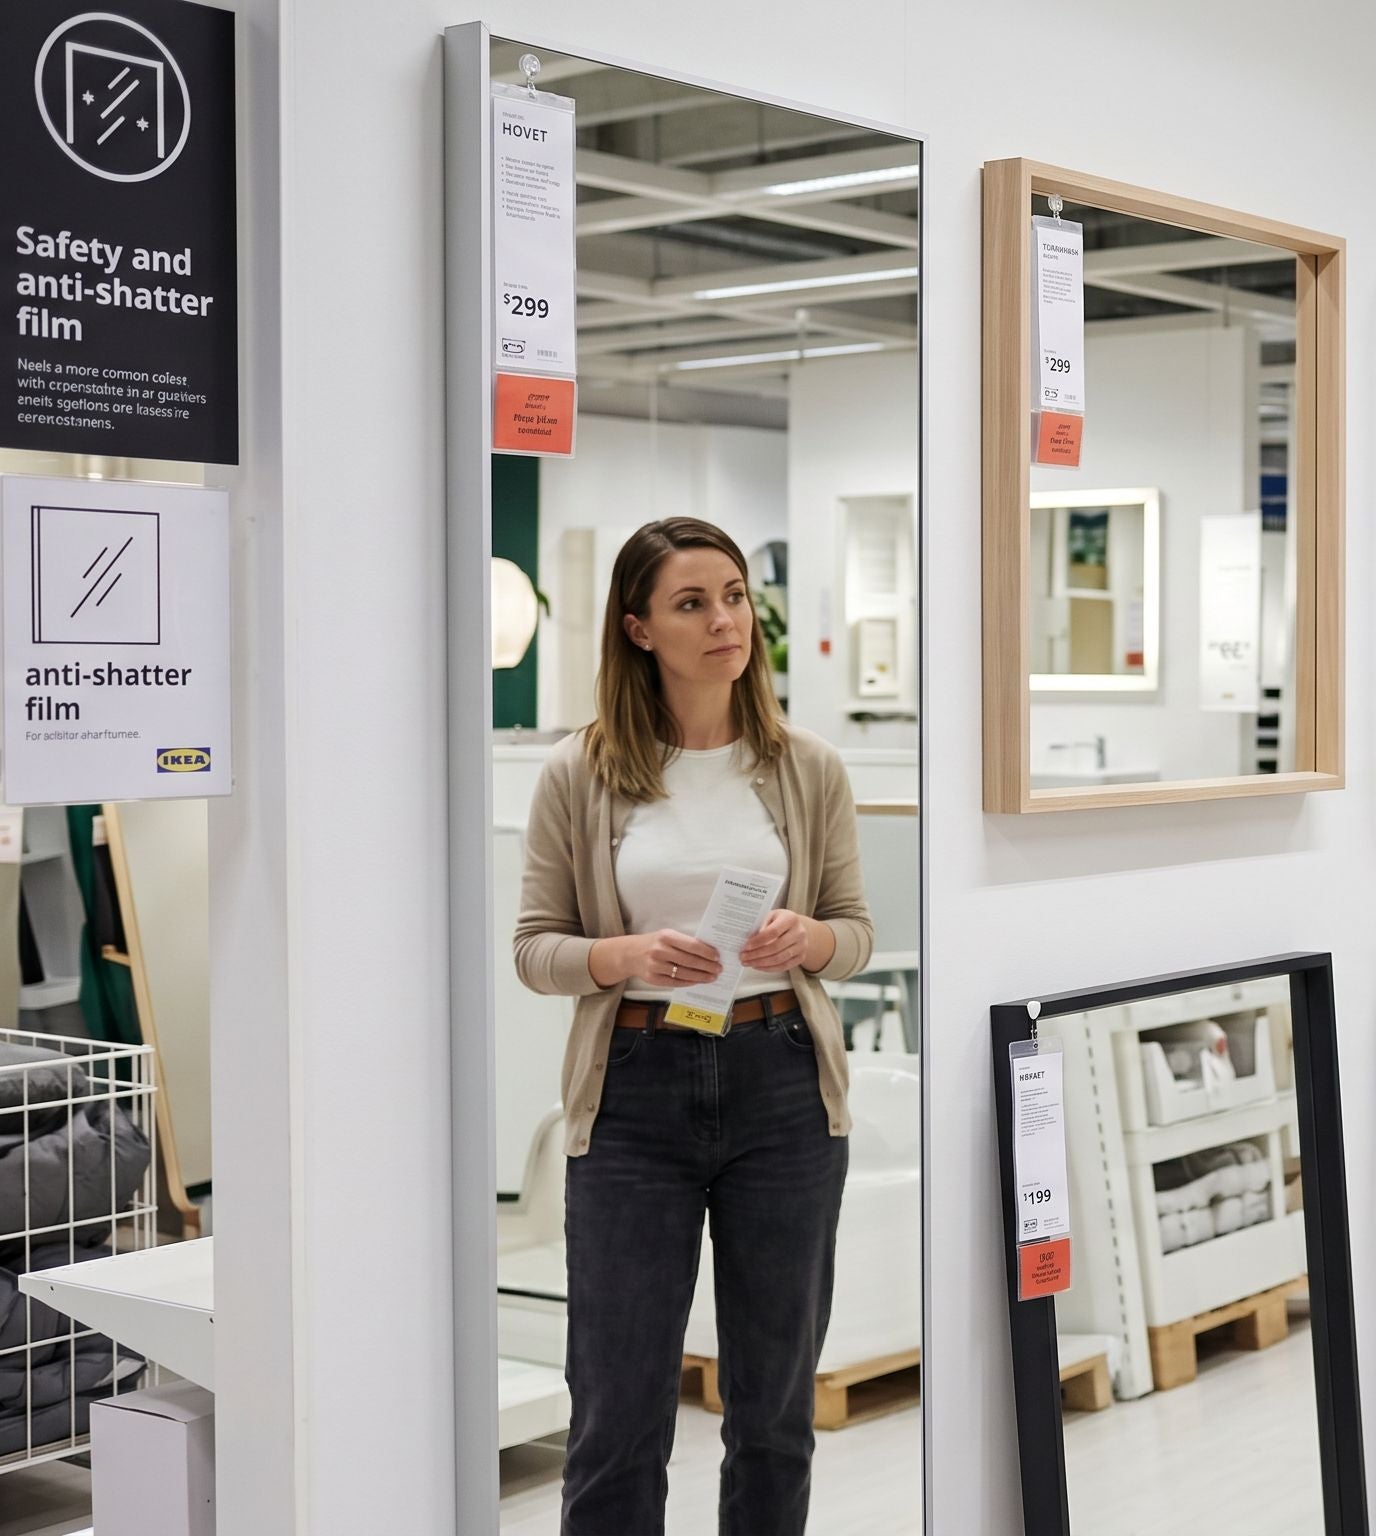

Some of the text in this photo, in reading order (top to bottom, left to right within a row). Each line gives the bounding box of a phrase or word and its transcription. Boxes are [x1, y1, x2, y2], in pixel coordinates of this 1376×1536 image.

[502, 121, 548, 143] HOVET
[16, 225, 192, 276] Safety and
[16, 270, 214, 317] anti-shatter
[503, 292, 549, 319] $299
[17, 305, 83, 342] film
[17, 376, 46, 390] with
[54, 363, 63, 374] a
[65, 365, 100, 378] more
[25, 661, 192, 686] anti-shatter
[24, 696, 80, 721] film
[25, 731, 41, 741] For
[162, 754, 207, 766] IKEA
